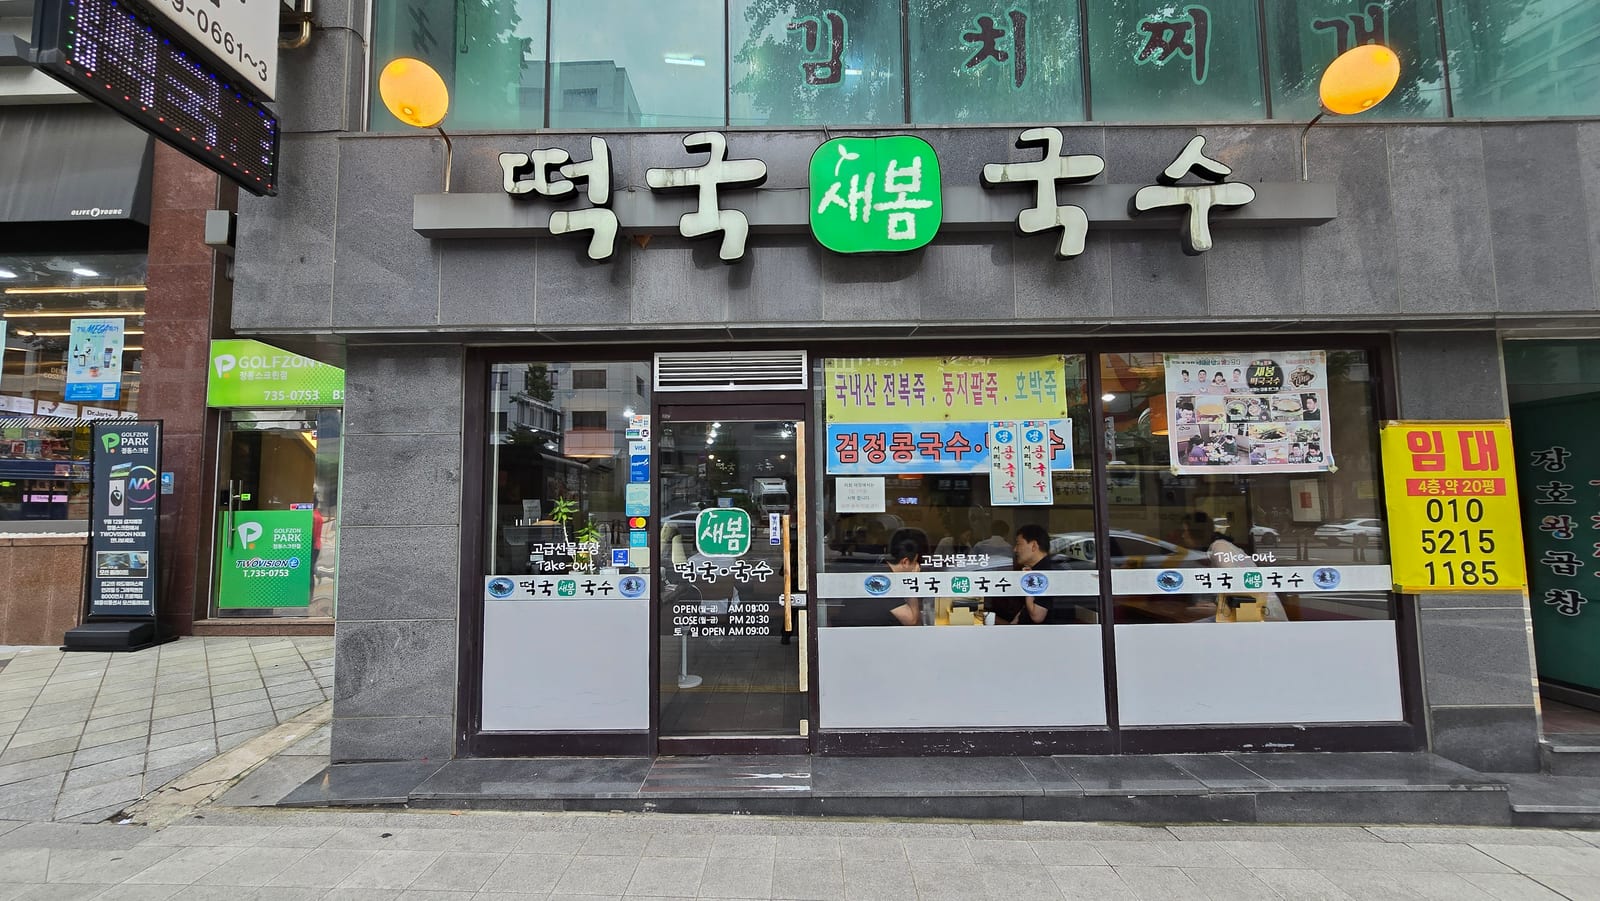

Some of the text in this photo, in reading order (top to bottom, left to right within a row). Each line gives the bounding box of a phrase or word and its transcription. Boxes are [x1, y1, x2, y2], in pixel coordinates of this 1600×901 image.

[499, 127, 1256, 261] 떡국 새봄 국수
[264, 390, 319, 400] 735-0753
[834, 373, 877, 407] 국내산
[1014, 370, 1058, 404] 호박죽
[121, 437, 149, 446] PARK
[1406, 431, 1500, 471] 임대
[1463, 480, 1496, 494] 20평
[1426, 498, 1484, 523] 010
[273, 534, 301, 542] PARK
[701, 516, 746, 551] 새봄
[1531, 446, 1588, 616] 장호왕곱창
[531, 542, 600, 556] 고급선물포장
[1421, 530, 1495, 555] 5215
[236, 559, 288, 569] TWOVISION
[920, 553, 990, 568] 고급선물포장
[1214, 551, 1277, 563] Take-out
[535, 560, 597, 572] Take-out
[243, 569, 289, 578] T.735-0753
[1195, 572, 1233, 589] 떡국
[1267, 572, 1304, 588] 국수
[1424, 561, 1499, 586] 1185
[520, 580, 554, 596] 떡국
[580, 580, 614, 596] 국수
[903, 577, 941, 593] 떡국
[974, 577, 1012, 593] 국수
[728, 604, 743, 613] AM
[729, 615, 743, 624] PM
[745, 615, 770, 624] 20:30
[690, 626, 699, 637] 일
[702, 627, 725, 636] OPEN
[728, 627, 743, 636] AM
[745, 626, 770, 636] 09:00
